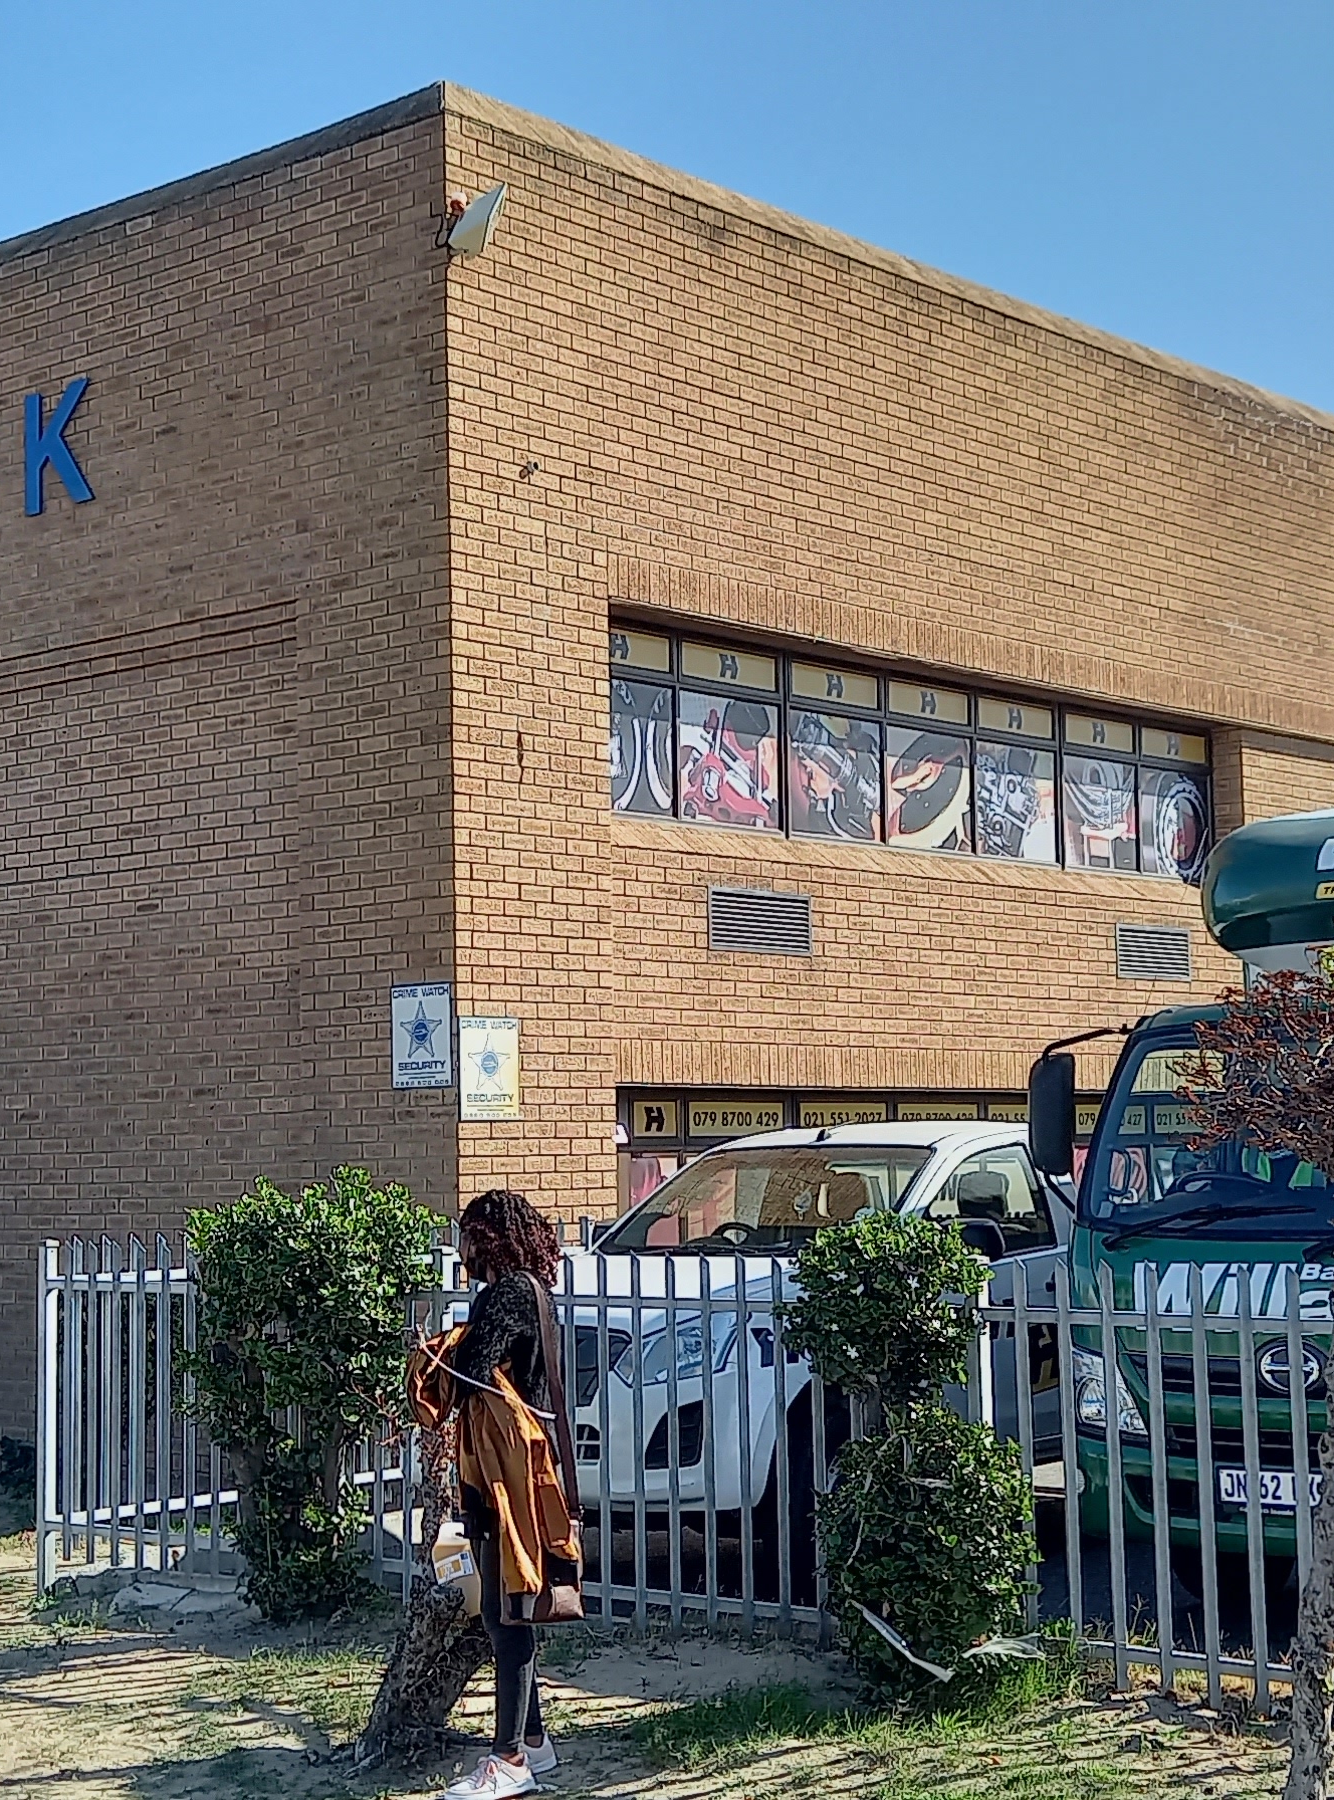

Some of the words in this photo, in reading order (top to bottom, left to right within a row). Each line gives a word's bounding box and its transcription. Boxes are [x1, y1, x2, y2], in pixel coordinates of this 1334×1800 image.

[392, 987, 418, 999] CRIME
[421, 985, 449, 997] WATCH
[398, 1059, 447, 1072] SECURITY
[466, 1093, 514, 1104] SECURITY
[693, 1111, 717, 1127] 079
[721, 1111, 752, 1127] 8700
[756, 1111, 779, 1127] 429
[803, 1111, 824, 1127] 021
[830, 1111, 850, 1126] 551
[1078, 1112, 1096, 1126] 079
